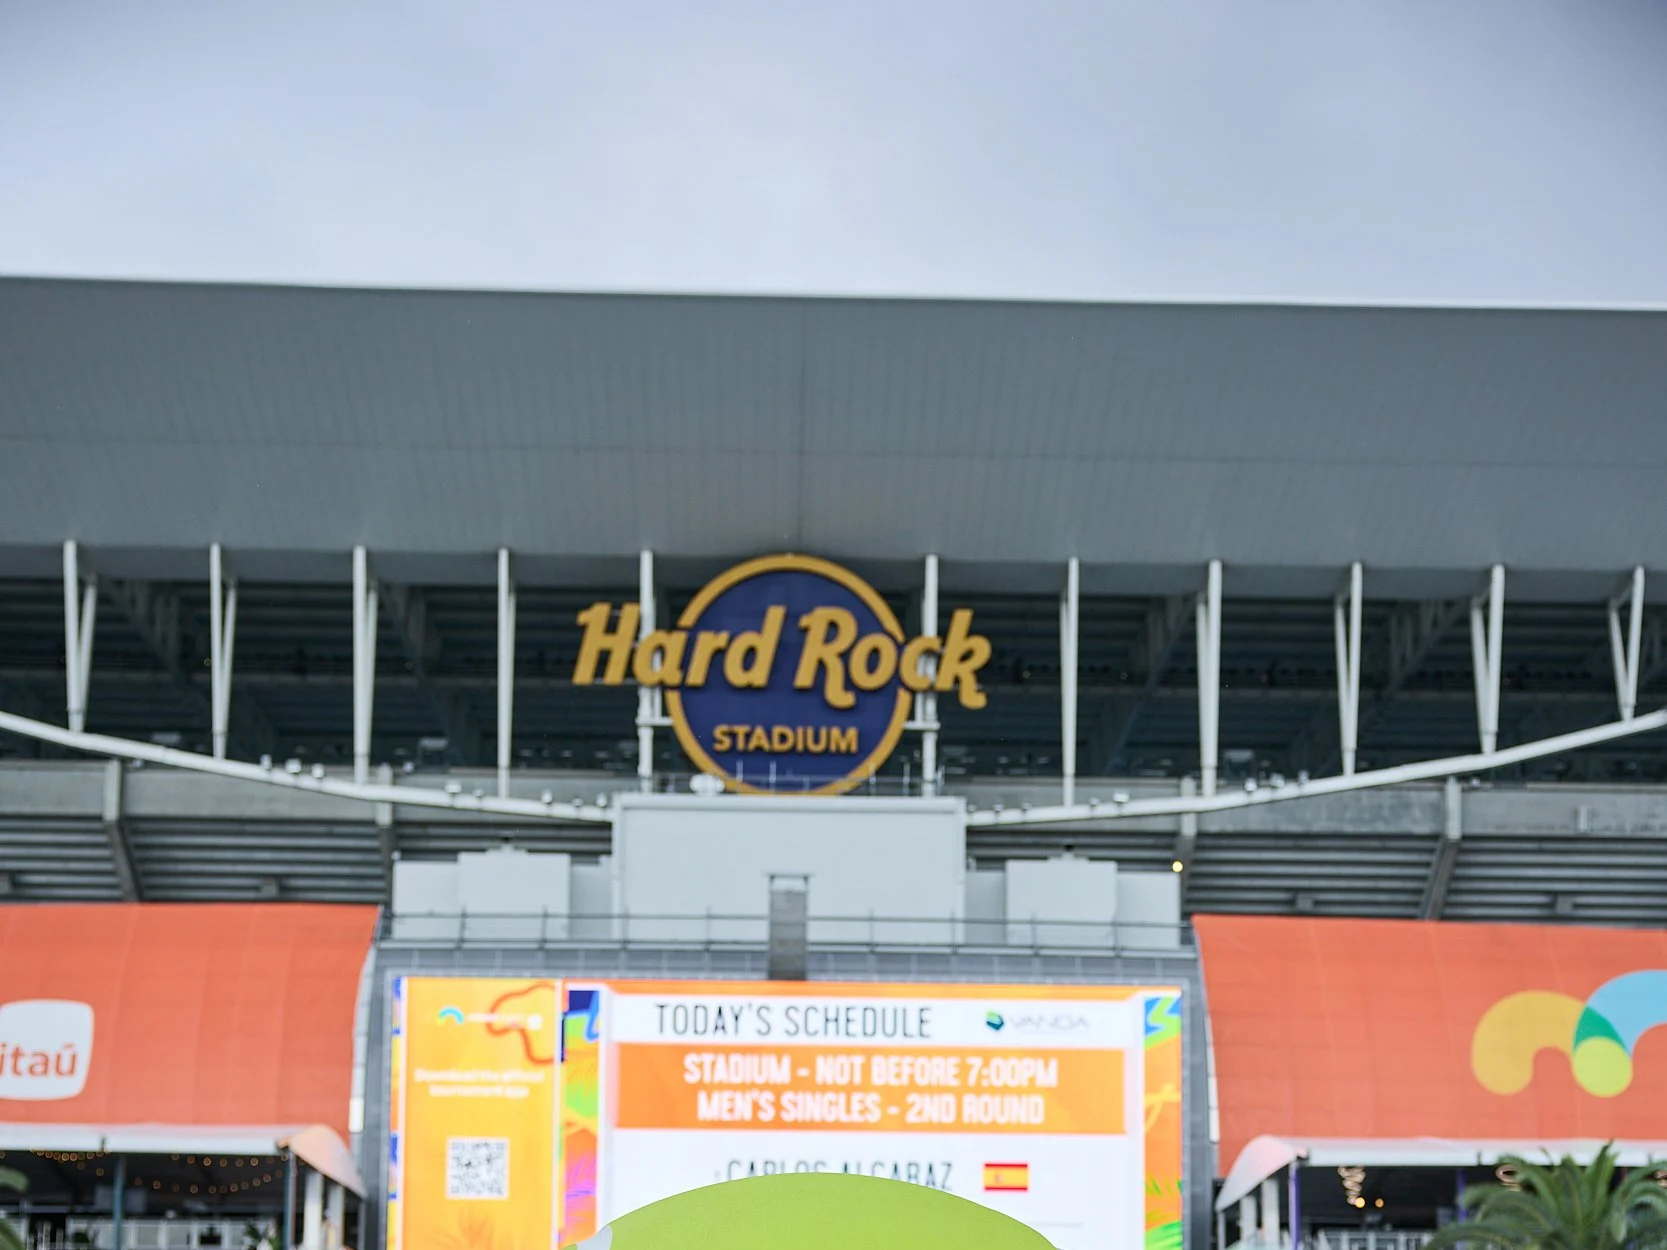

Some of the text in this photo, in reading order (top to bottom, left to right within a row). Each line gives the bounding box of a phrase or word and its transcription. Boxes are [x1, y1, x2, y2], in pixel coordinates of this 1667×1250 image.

[572, 602, 992, 710] Hard Rock
[713, 724, 859, 754] STADIUM
[655, 1003, 932, 1038] TODAY'S SCHEDULE
[0, 1042, 77, 1077] itaú
[684, 1053, 791, 1085] STADIUM
[815, 1055, 865, 1086] NOT
[870, 1055, 960, 1087] BEFORE
[966, 1057, 1058, 1088] 7:00PM
[697, 1089, 775, 1121] MEN'S
[780, 1091, 881, 1123] SINGLES
[904, 1092, 956, 1124] 2ND
[962, 1094, 1045, 1125] ROUND
